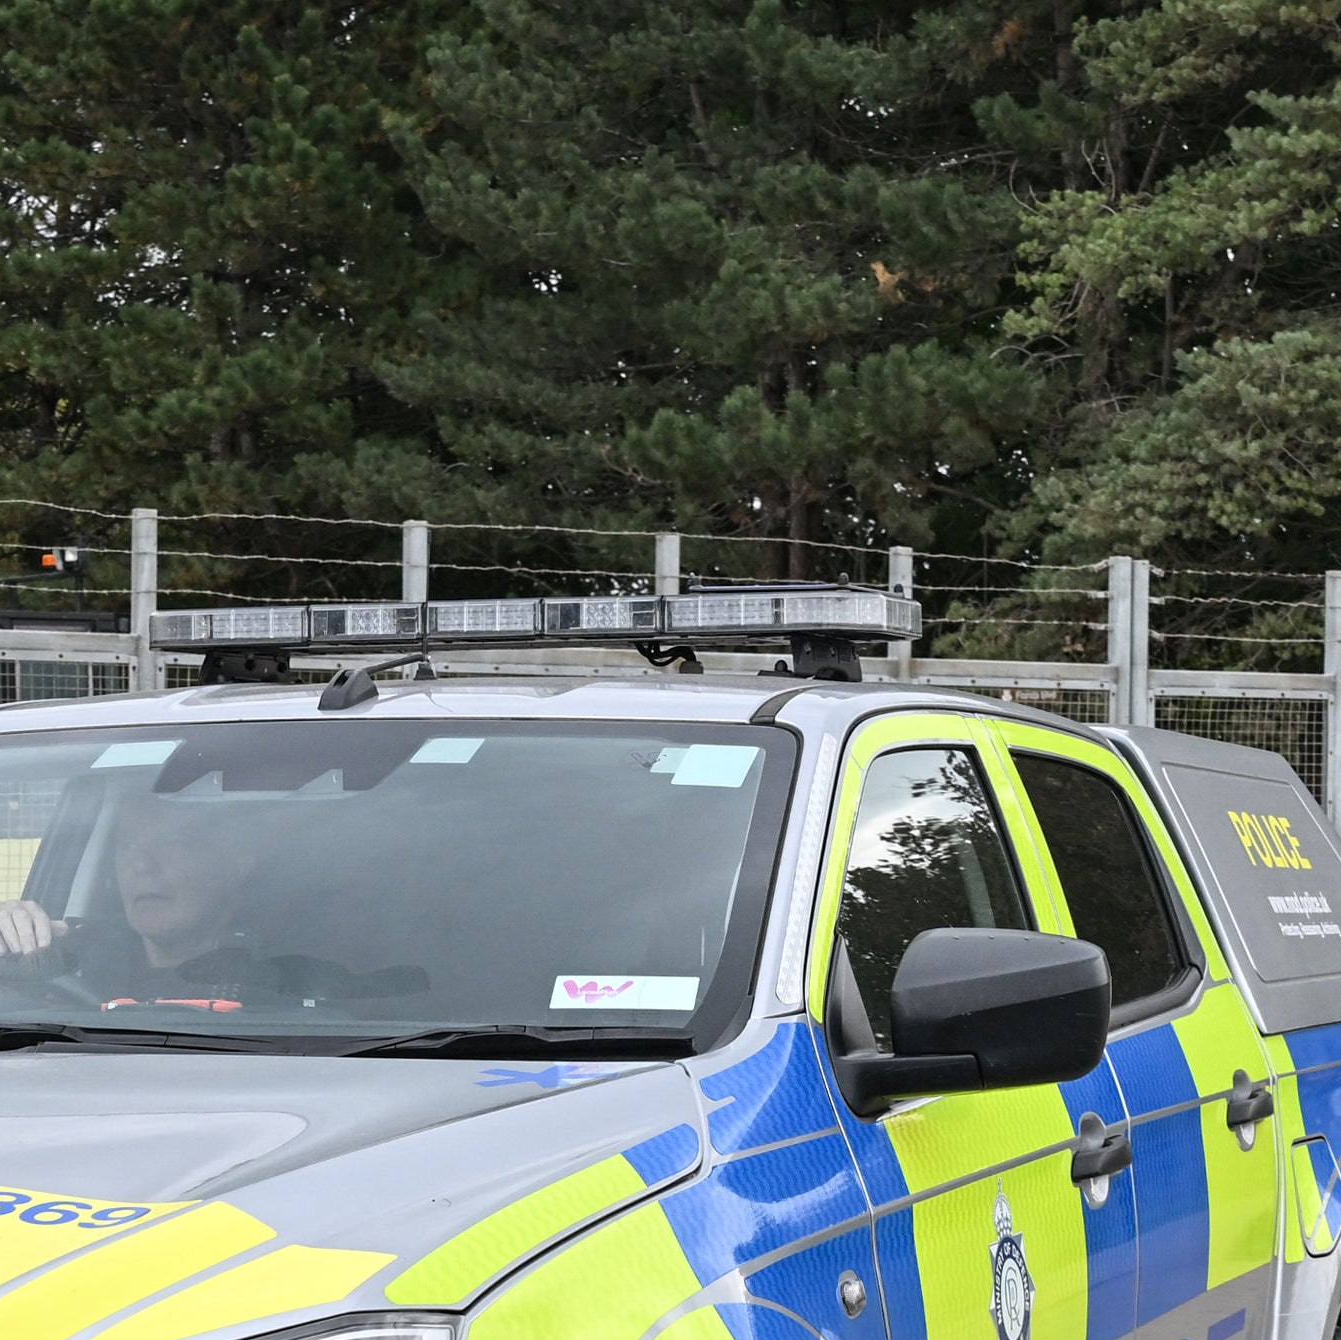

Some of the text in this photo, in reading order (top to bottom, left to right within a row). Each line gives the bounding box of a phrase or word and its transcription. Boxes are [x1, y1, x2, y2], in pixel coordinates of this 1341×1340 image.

[1227, 810, 1313, 870] POLICE
[995, 1241, 1031, 1326] MINISTRY OF DEFENCE
